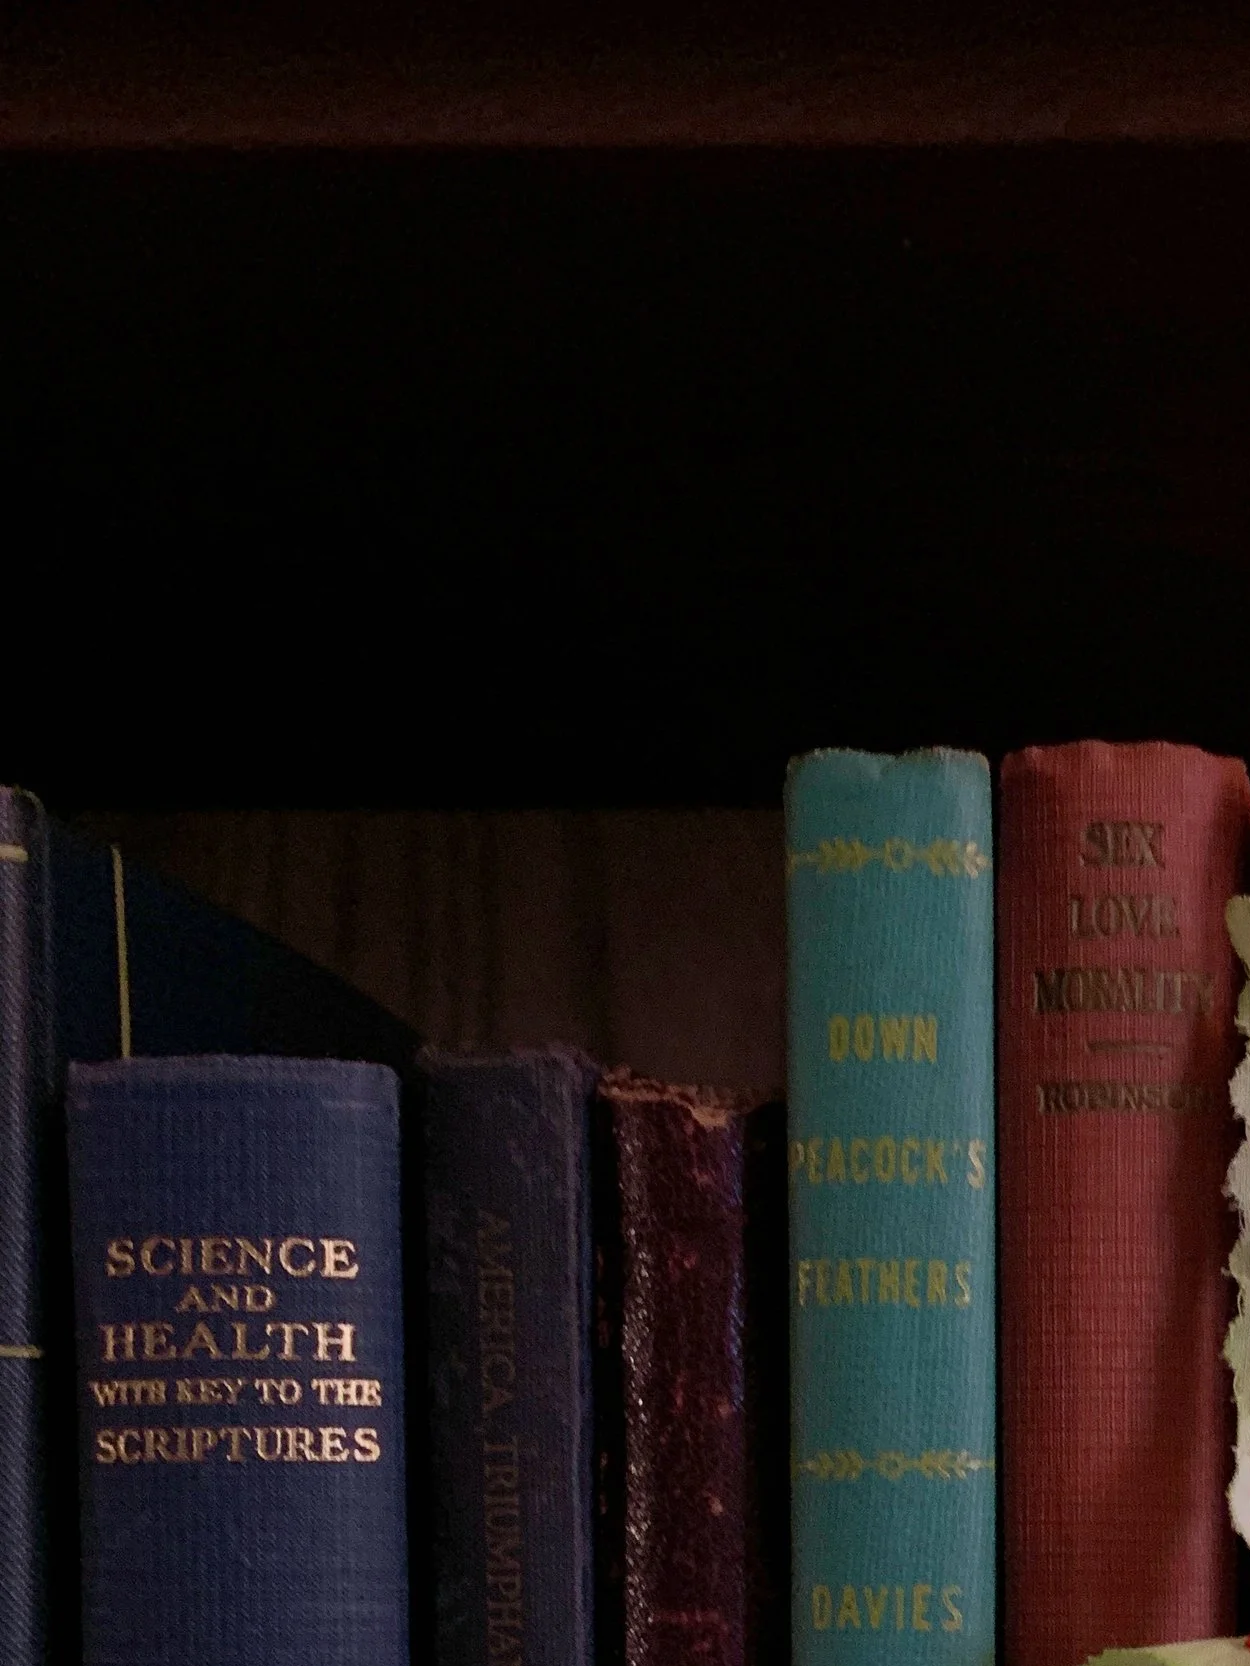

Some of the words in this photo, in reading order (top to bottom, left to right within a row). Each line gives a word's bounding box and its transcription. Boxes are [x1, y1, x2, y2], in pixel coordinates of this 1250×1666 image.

[1079, 821, 1166, 869] SEX
[1070, 893, 1181, 940] LOVE
[1033, 966, 1215, 1014] MORALITY
[828, 1013, 938, 1064] DOWN
[788, 1136, 986, 1189] PEACOCK'S
[104, 1236, 359, 1280] SCIENCE
[175, 1284, 276, 1315] AND
[797, 1257, 971, 1308] FEATHERS
[475, 1208, 515, 1413] AMERICA
[99, 1320, 357, 1363] HEALTH
[90, 1378, 168, 1408] WITH
[174, 1378, 248, 1406] KEY
[254, 1379, 302, 1405] TO
[311, 1379, 382, 1408] THE
[95, 1426, 383, 1465] SCRIPTURES
[811, 1583, 964, 1632] DAVIES
